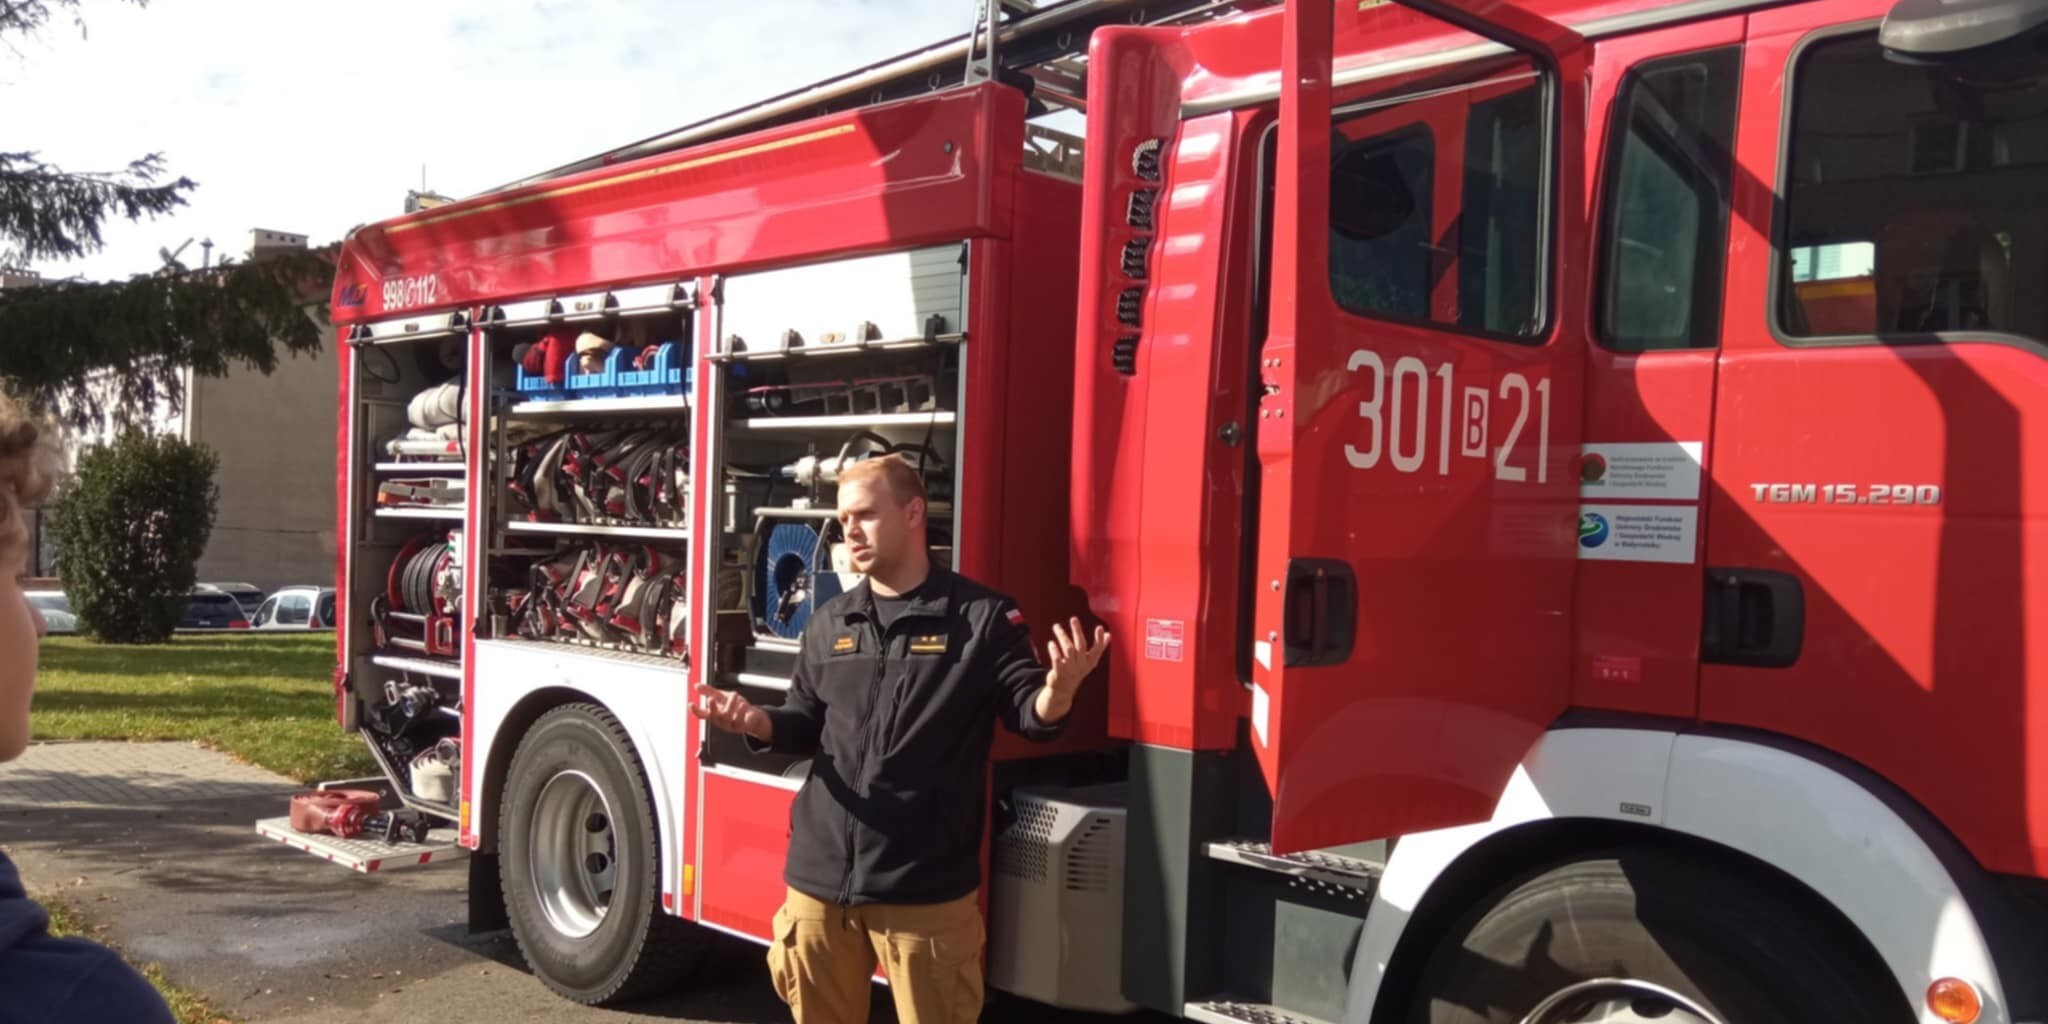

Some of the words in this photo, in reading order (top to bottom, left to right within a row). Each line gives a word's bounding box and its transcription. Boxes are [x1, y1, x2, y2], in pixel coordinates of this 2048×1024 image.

[383, 280, 404, 311] 998
[417, 274, 437, 305] 112
[1344, 349, 1453, 475] 301
[1467, 392, 1485, 451] B
[1496, 372, 1550, 483] 21
[1750, 483, 1816, 504] TGM
[1822, 484, 1941, 505] 15.290
